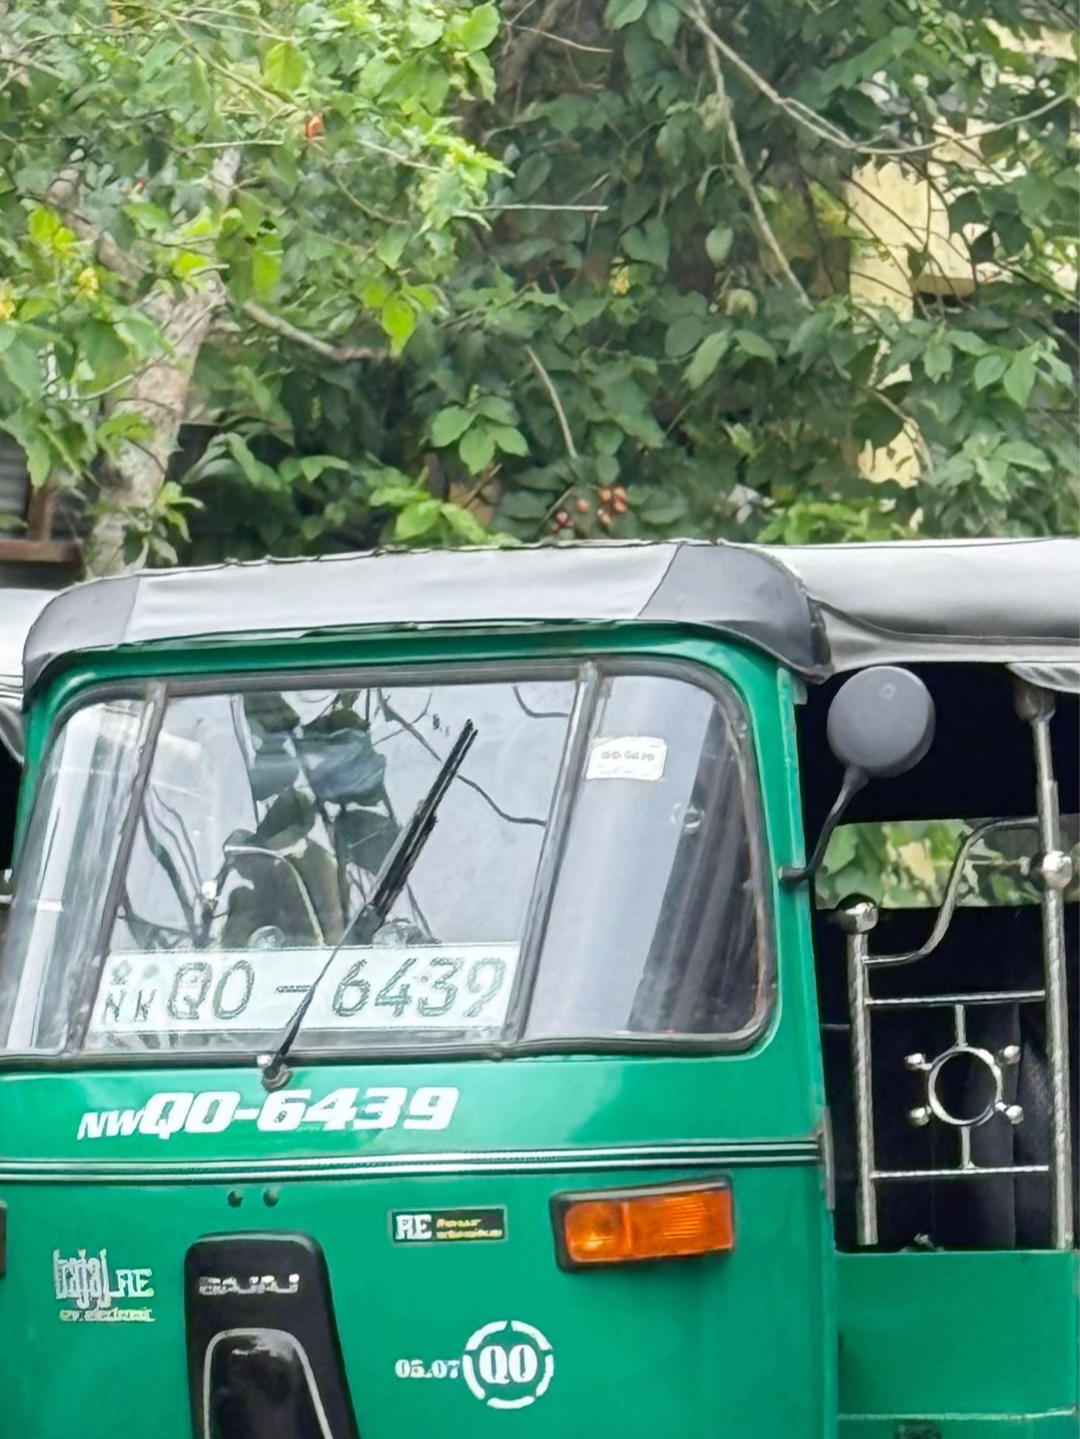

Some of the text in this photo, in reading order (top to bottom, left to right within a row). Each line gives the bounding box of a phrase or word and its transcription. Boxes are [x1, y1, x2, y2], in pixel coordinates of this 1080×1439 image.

[332, 956, 508, 1019] 6439
[395, 1213, 433, 1240] RE
[478, 1343, 538, 1385] QO
